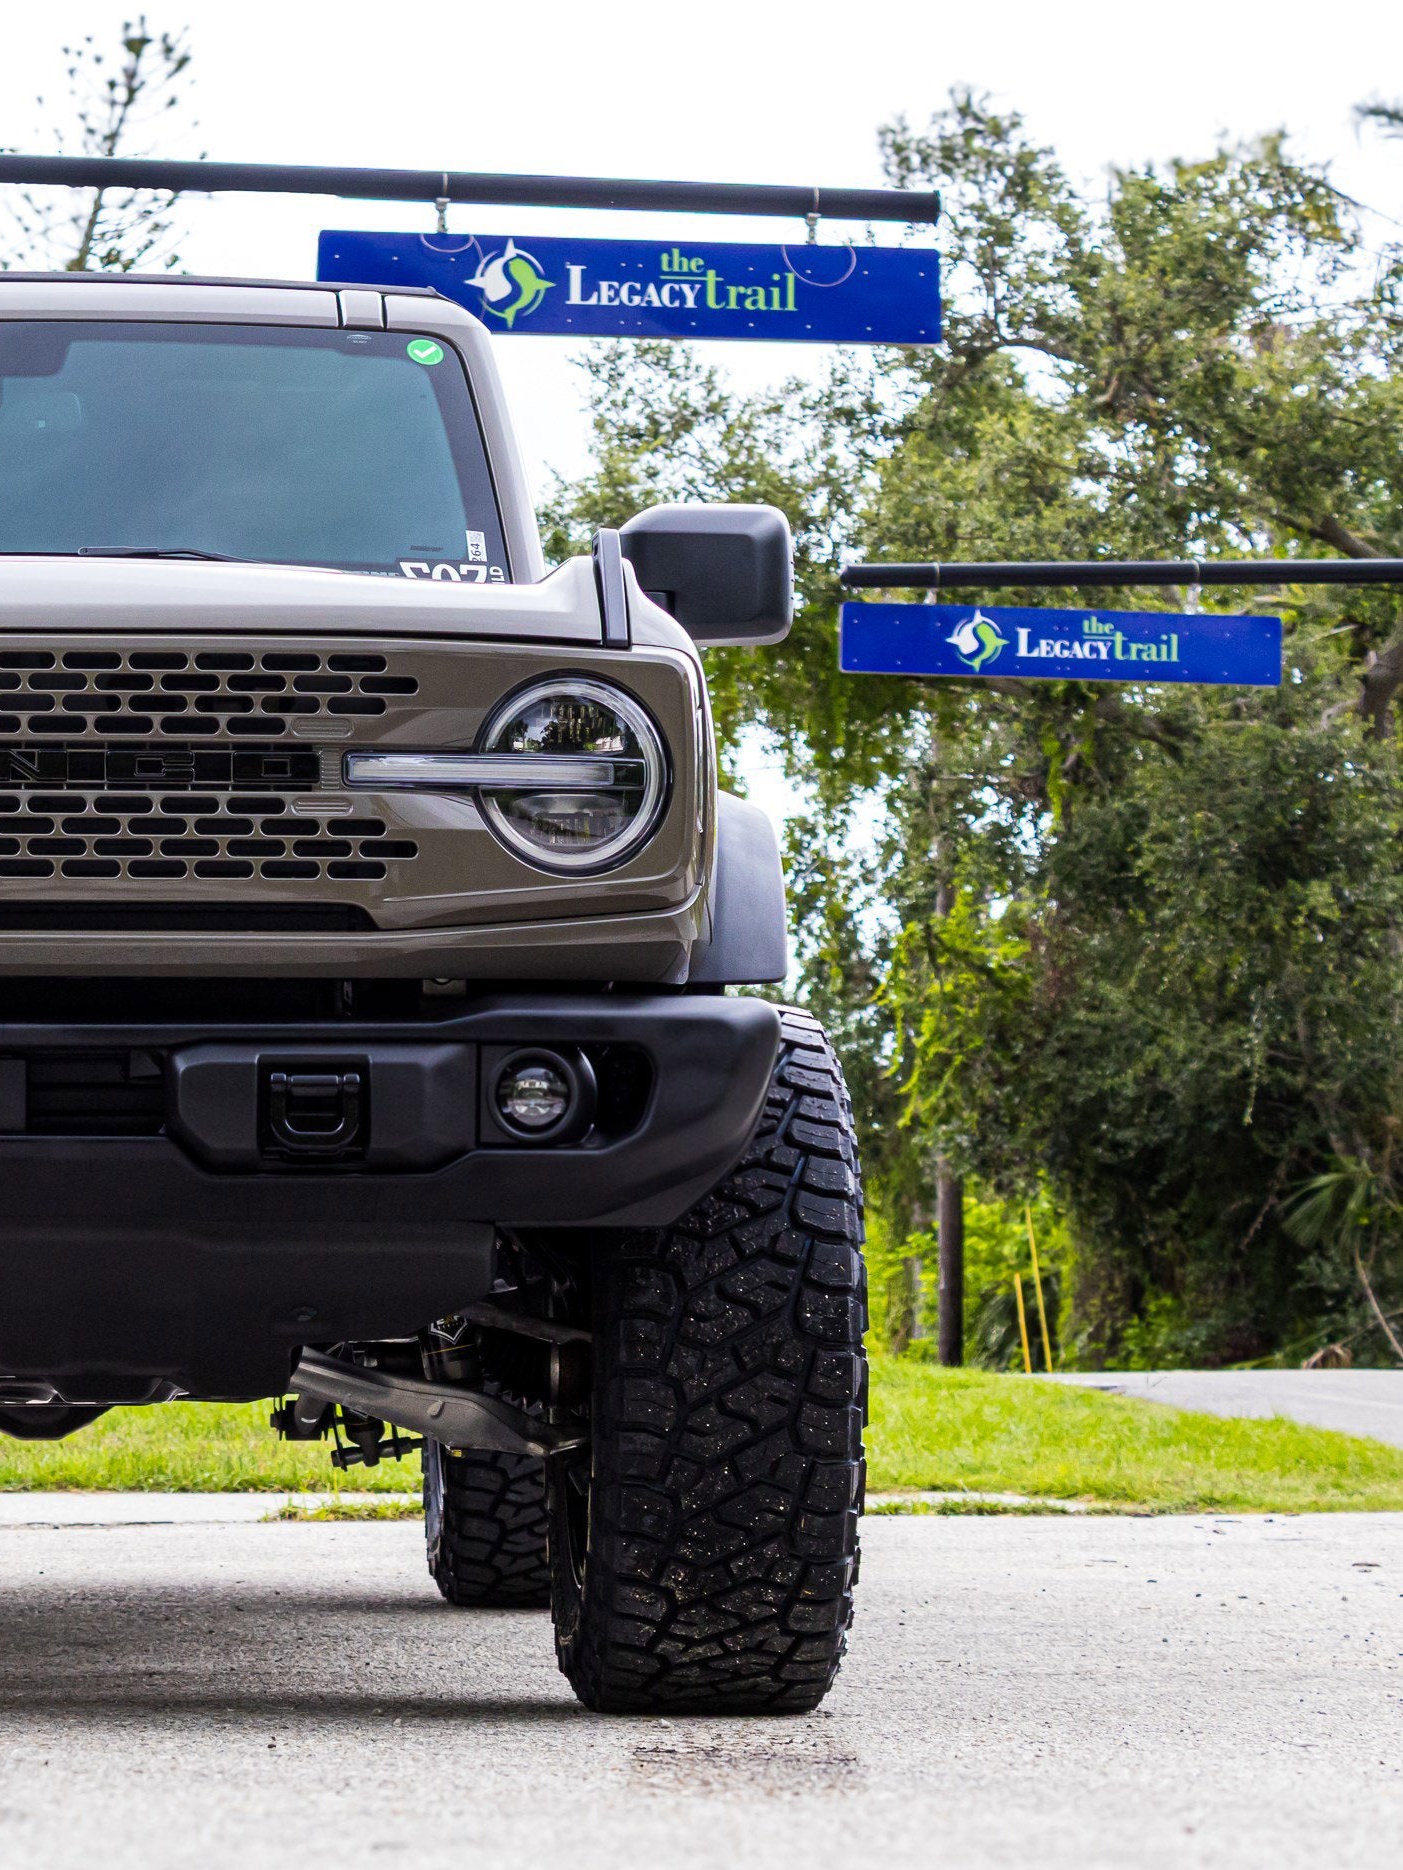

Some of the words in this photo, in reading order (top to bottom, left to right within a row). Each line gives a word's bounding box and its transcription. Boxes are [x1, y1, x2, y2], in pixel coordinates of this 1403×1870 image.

[660, 248, 705, 273] the
[564, 264, 702, 308] LEGACY
[705, 269, 799, 311] trail
[1082, 616, 1115, 635] the
[1015, 627, 1112, 660] LEGACY
[1113, 631, 1180, 662] trail
